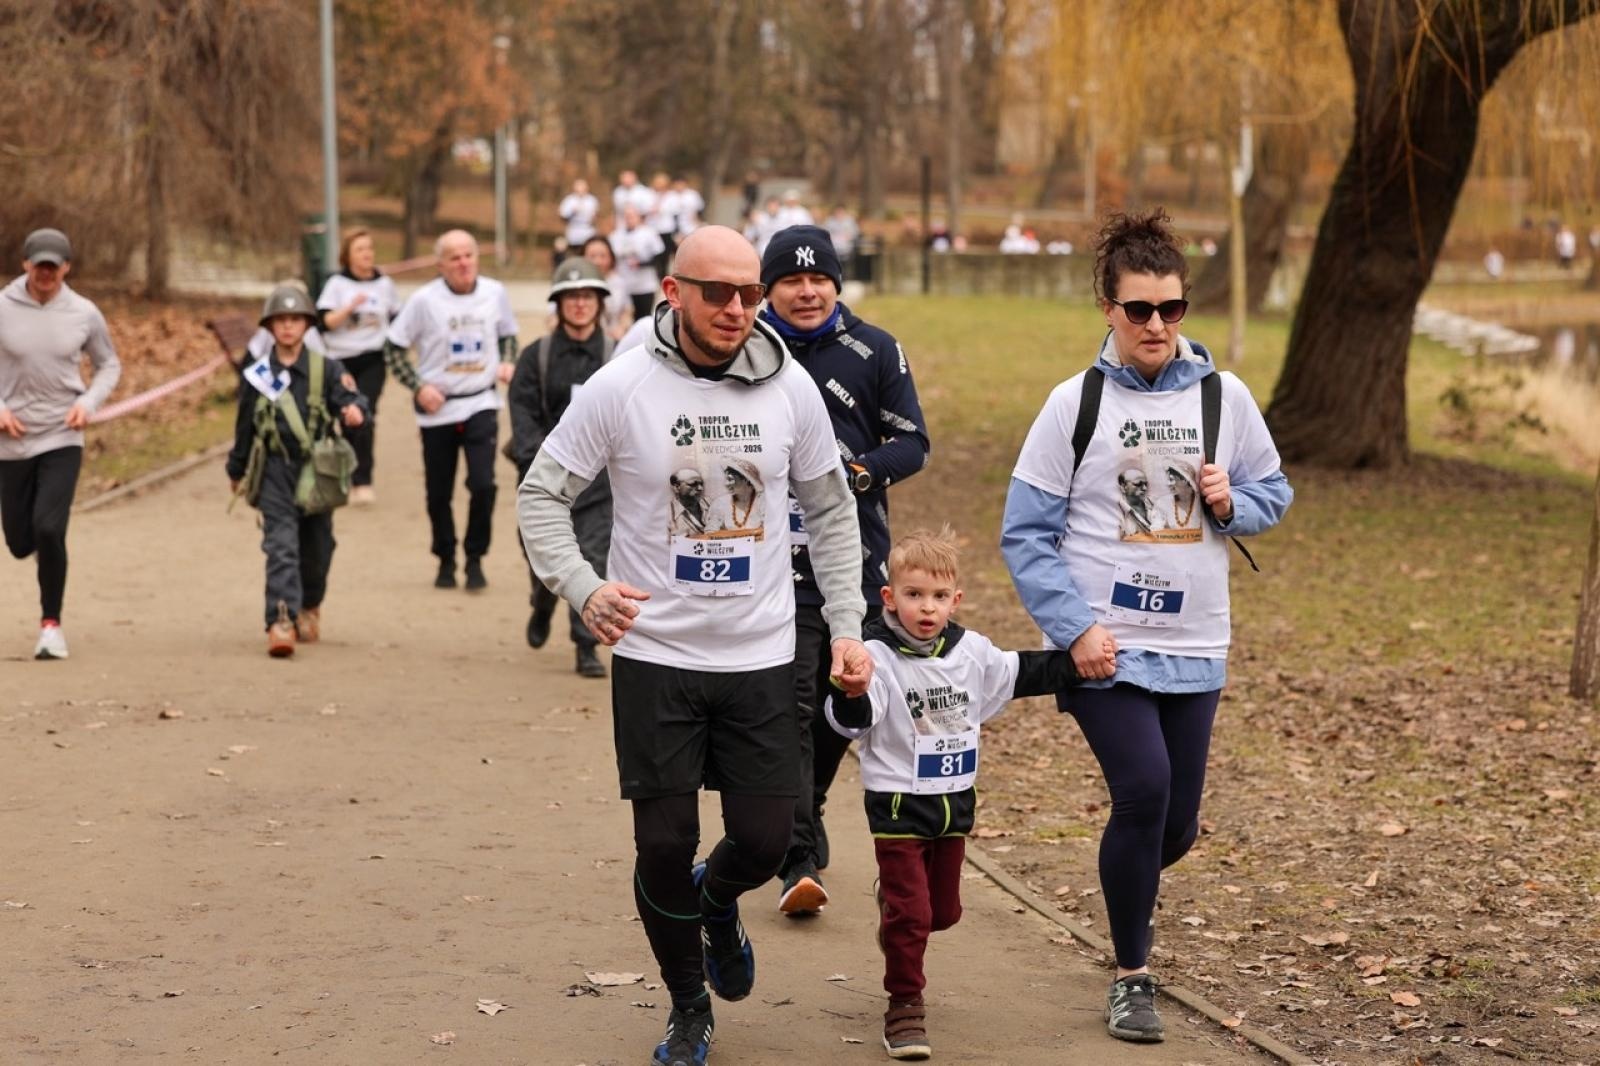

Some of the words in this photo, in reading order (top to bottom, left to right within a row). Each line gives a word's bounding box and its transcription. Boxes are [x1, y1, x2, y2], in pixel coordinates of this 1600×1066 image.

[825, 378, 856, 409] BRKLN
[699, 416, 729, 424] TROPEM
[1144, 419, 1172, 427] TROPEM
[700, 423, 760, 439] WILCZYM
[1145, 428, 1198, 441] WILCZYM
[743, 444, 762, 453] 2026
[1183, 446, 1200, 454] 2026
[700, 559, 731, 581] 82
[1137, 590, 1165, 611] 16
[925, 685, 952, 697] TROPEM
[940, 753, 963, 776] 81
